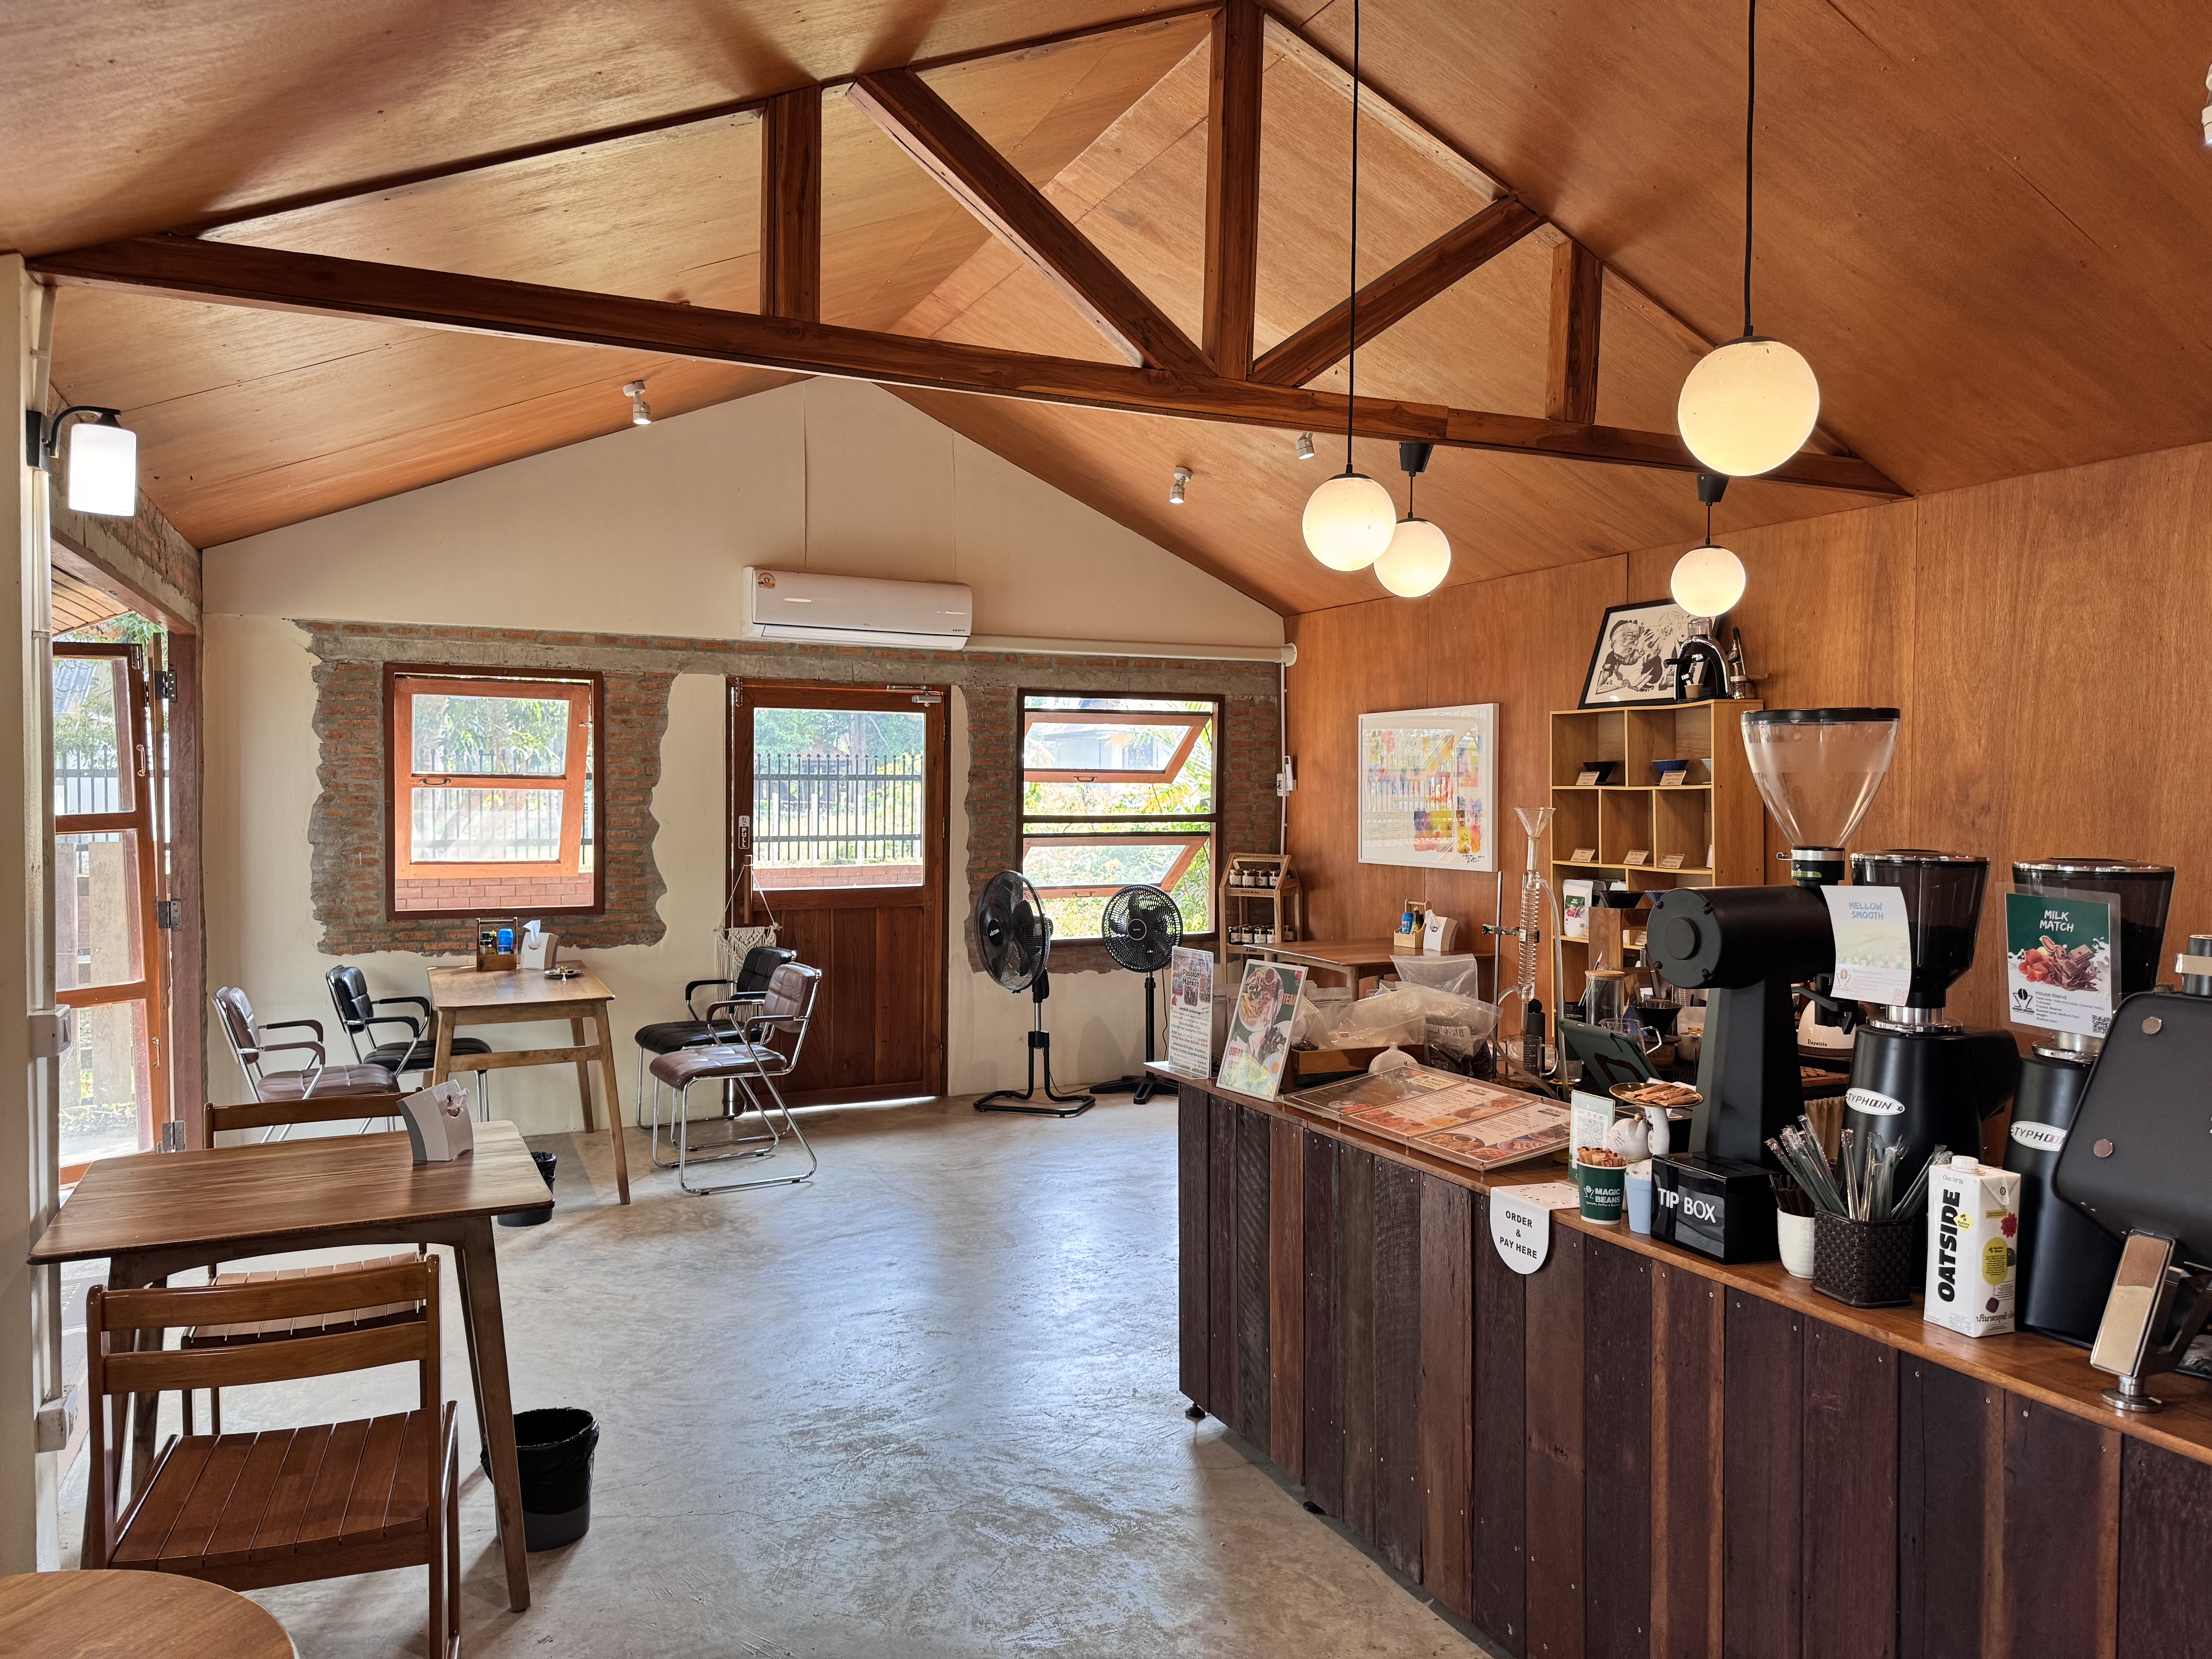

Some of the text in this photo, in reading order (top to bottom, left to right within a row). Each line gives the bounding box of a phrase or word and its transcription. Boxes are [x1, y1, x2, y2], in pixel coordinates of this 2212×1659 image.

[1849, 902, 1882, 910] MELLOW
[1851, 911, 1884, 920] SMOOTH
[2044, 910, 2069, 922] MILK
[2039, 920, 2074, 933] MATCH
[1183, 969, 1199, 978] Passion
[1183, 977, 1199, 988] Market
[1229, 1047, 1244, 1058] BREAK
[1228, 1060, 1238, 1070] FAST
[1848, 1093, 1892, 1110] TYPHOON
[1657, 1188, 1716, 1223] TIP BOX
[1506, 1211, 1532, 1228] ORDER
[1516, 1229, 1521, 1238] &
[1500, 1236, 1537, 1259] PAY HERE
[1937, 1189, 1960, 1302] OATSIDE
